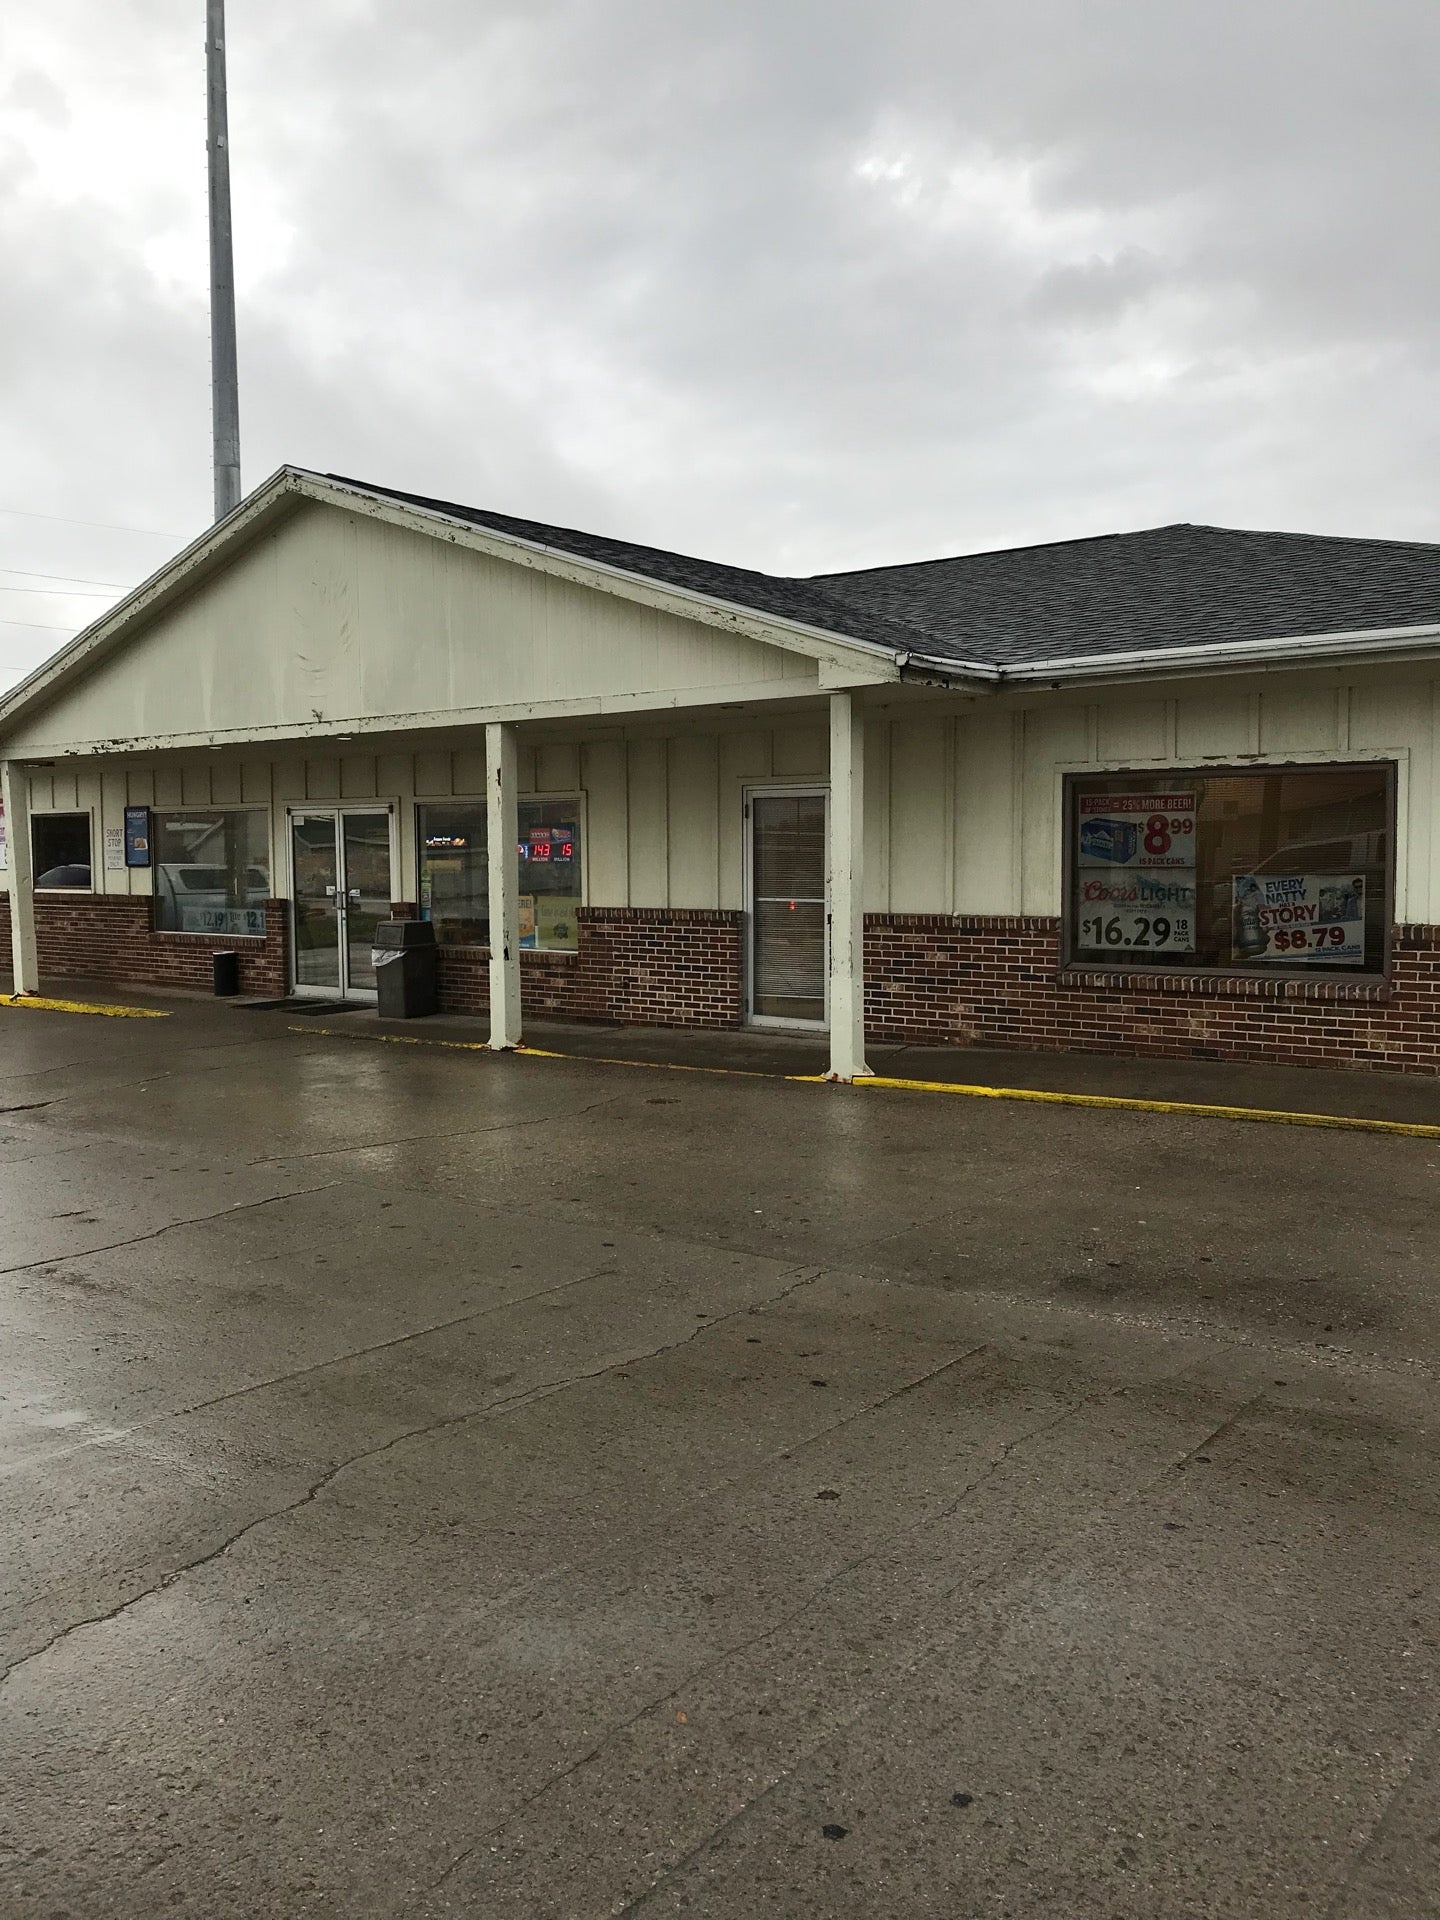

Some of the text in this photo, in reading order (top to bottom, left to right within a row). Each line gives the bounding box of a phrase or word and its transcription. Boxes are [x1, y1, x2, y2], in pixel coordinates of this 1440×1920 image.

[1122, 800, 1140, 810] 25%
[1142, 799, 1165, 810] MORE
[1167, 798, 1192, 808] BEER!
[106, 829, 123, 837] SHORT
[108, 838, 121, 847] STOP
[534, 843, 550, 856] 143
[562, 843, 572, 856] 15
[1148, 857, 1165, 865] PACK
[1166, 857, 1185, 865] CANS
[1083, 880, 1191, 901] Coors LIGHT
[1265, 877, 1305, 892] EVERY
[1265, 889, 1307, 904] NATTY
[1259, 904, 1317, 926] STORY
[1175, 919, 1188, 930] 18
[1082, 916, 1171, 947] $16.29
[1274, 926, 1345, 952] $8.79
